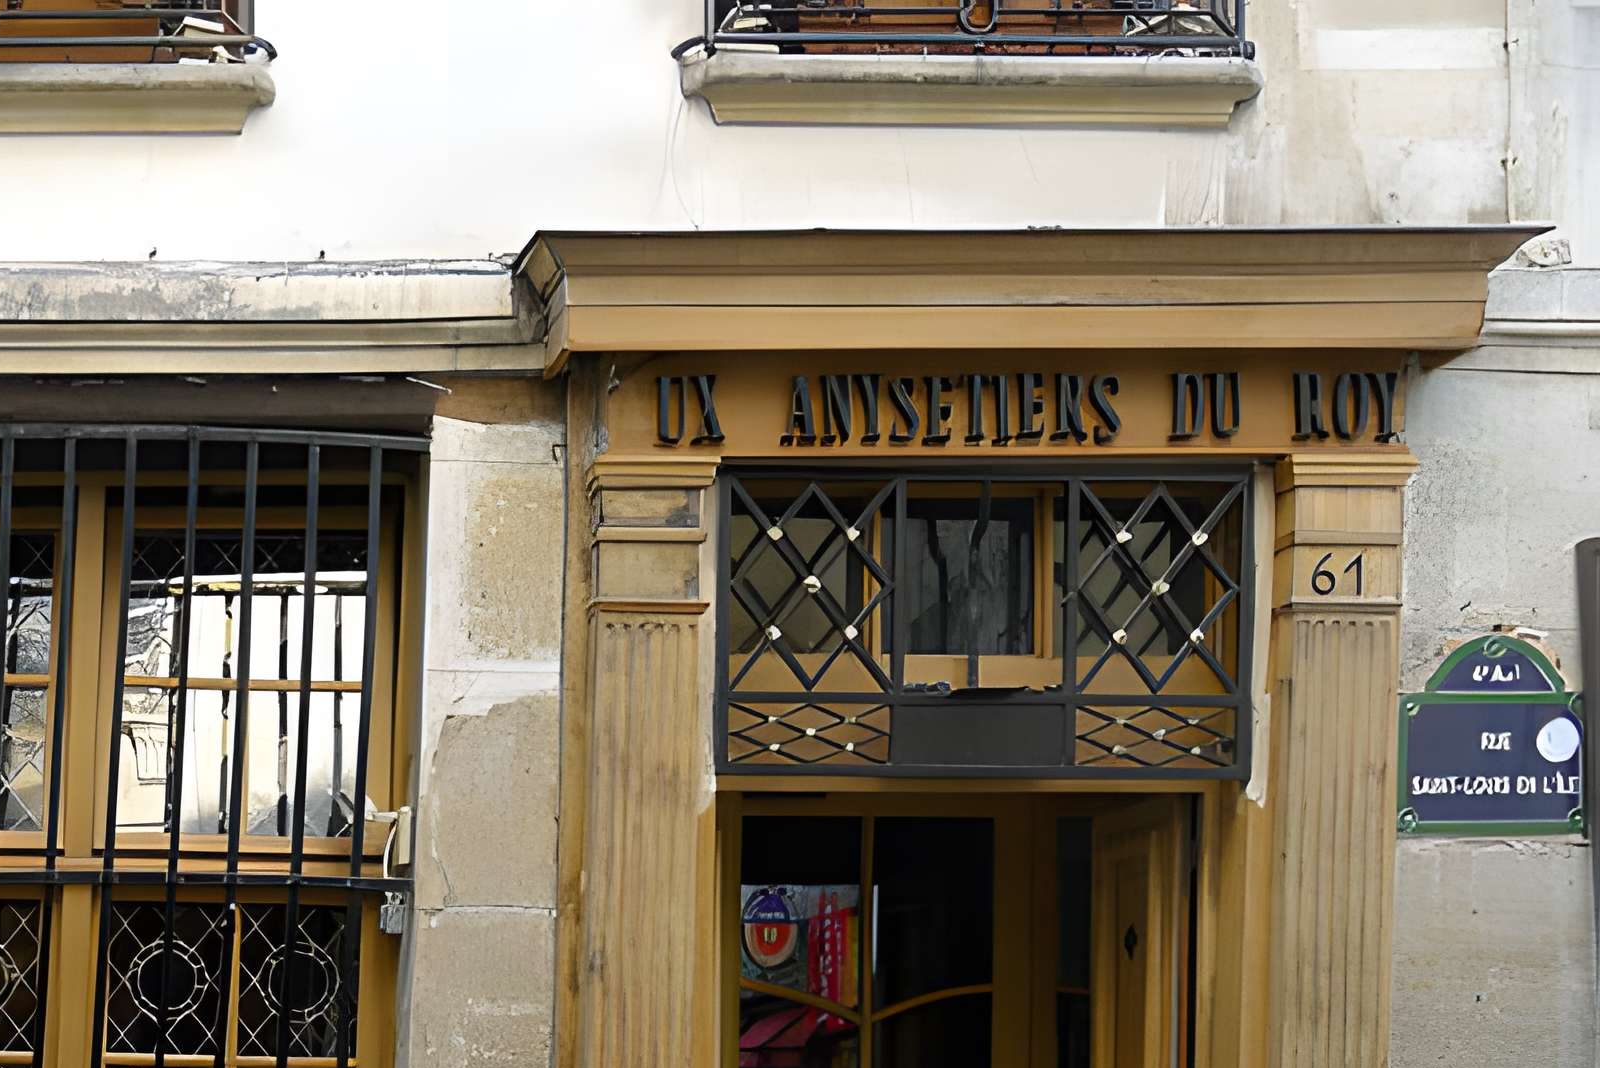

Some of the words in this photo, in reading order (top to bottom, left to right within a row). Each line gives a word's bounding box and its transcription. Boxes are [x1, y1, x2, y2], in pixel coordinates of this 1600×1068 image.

[655, 373, 726, 447] UX
[779, 372, 1122, 447] ANYSETIERS
[1167, 372, 1241, 441] DU
[1291, 372, 1400, 443] ROY
[1311, 552, 1363, 596] 61
